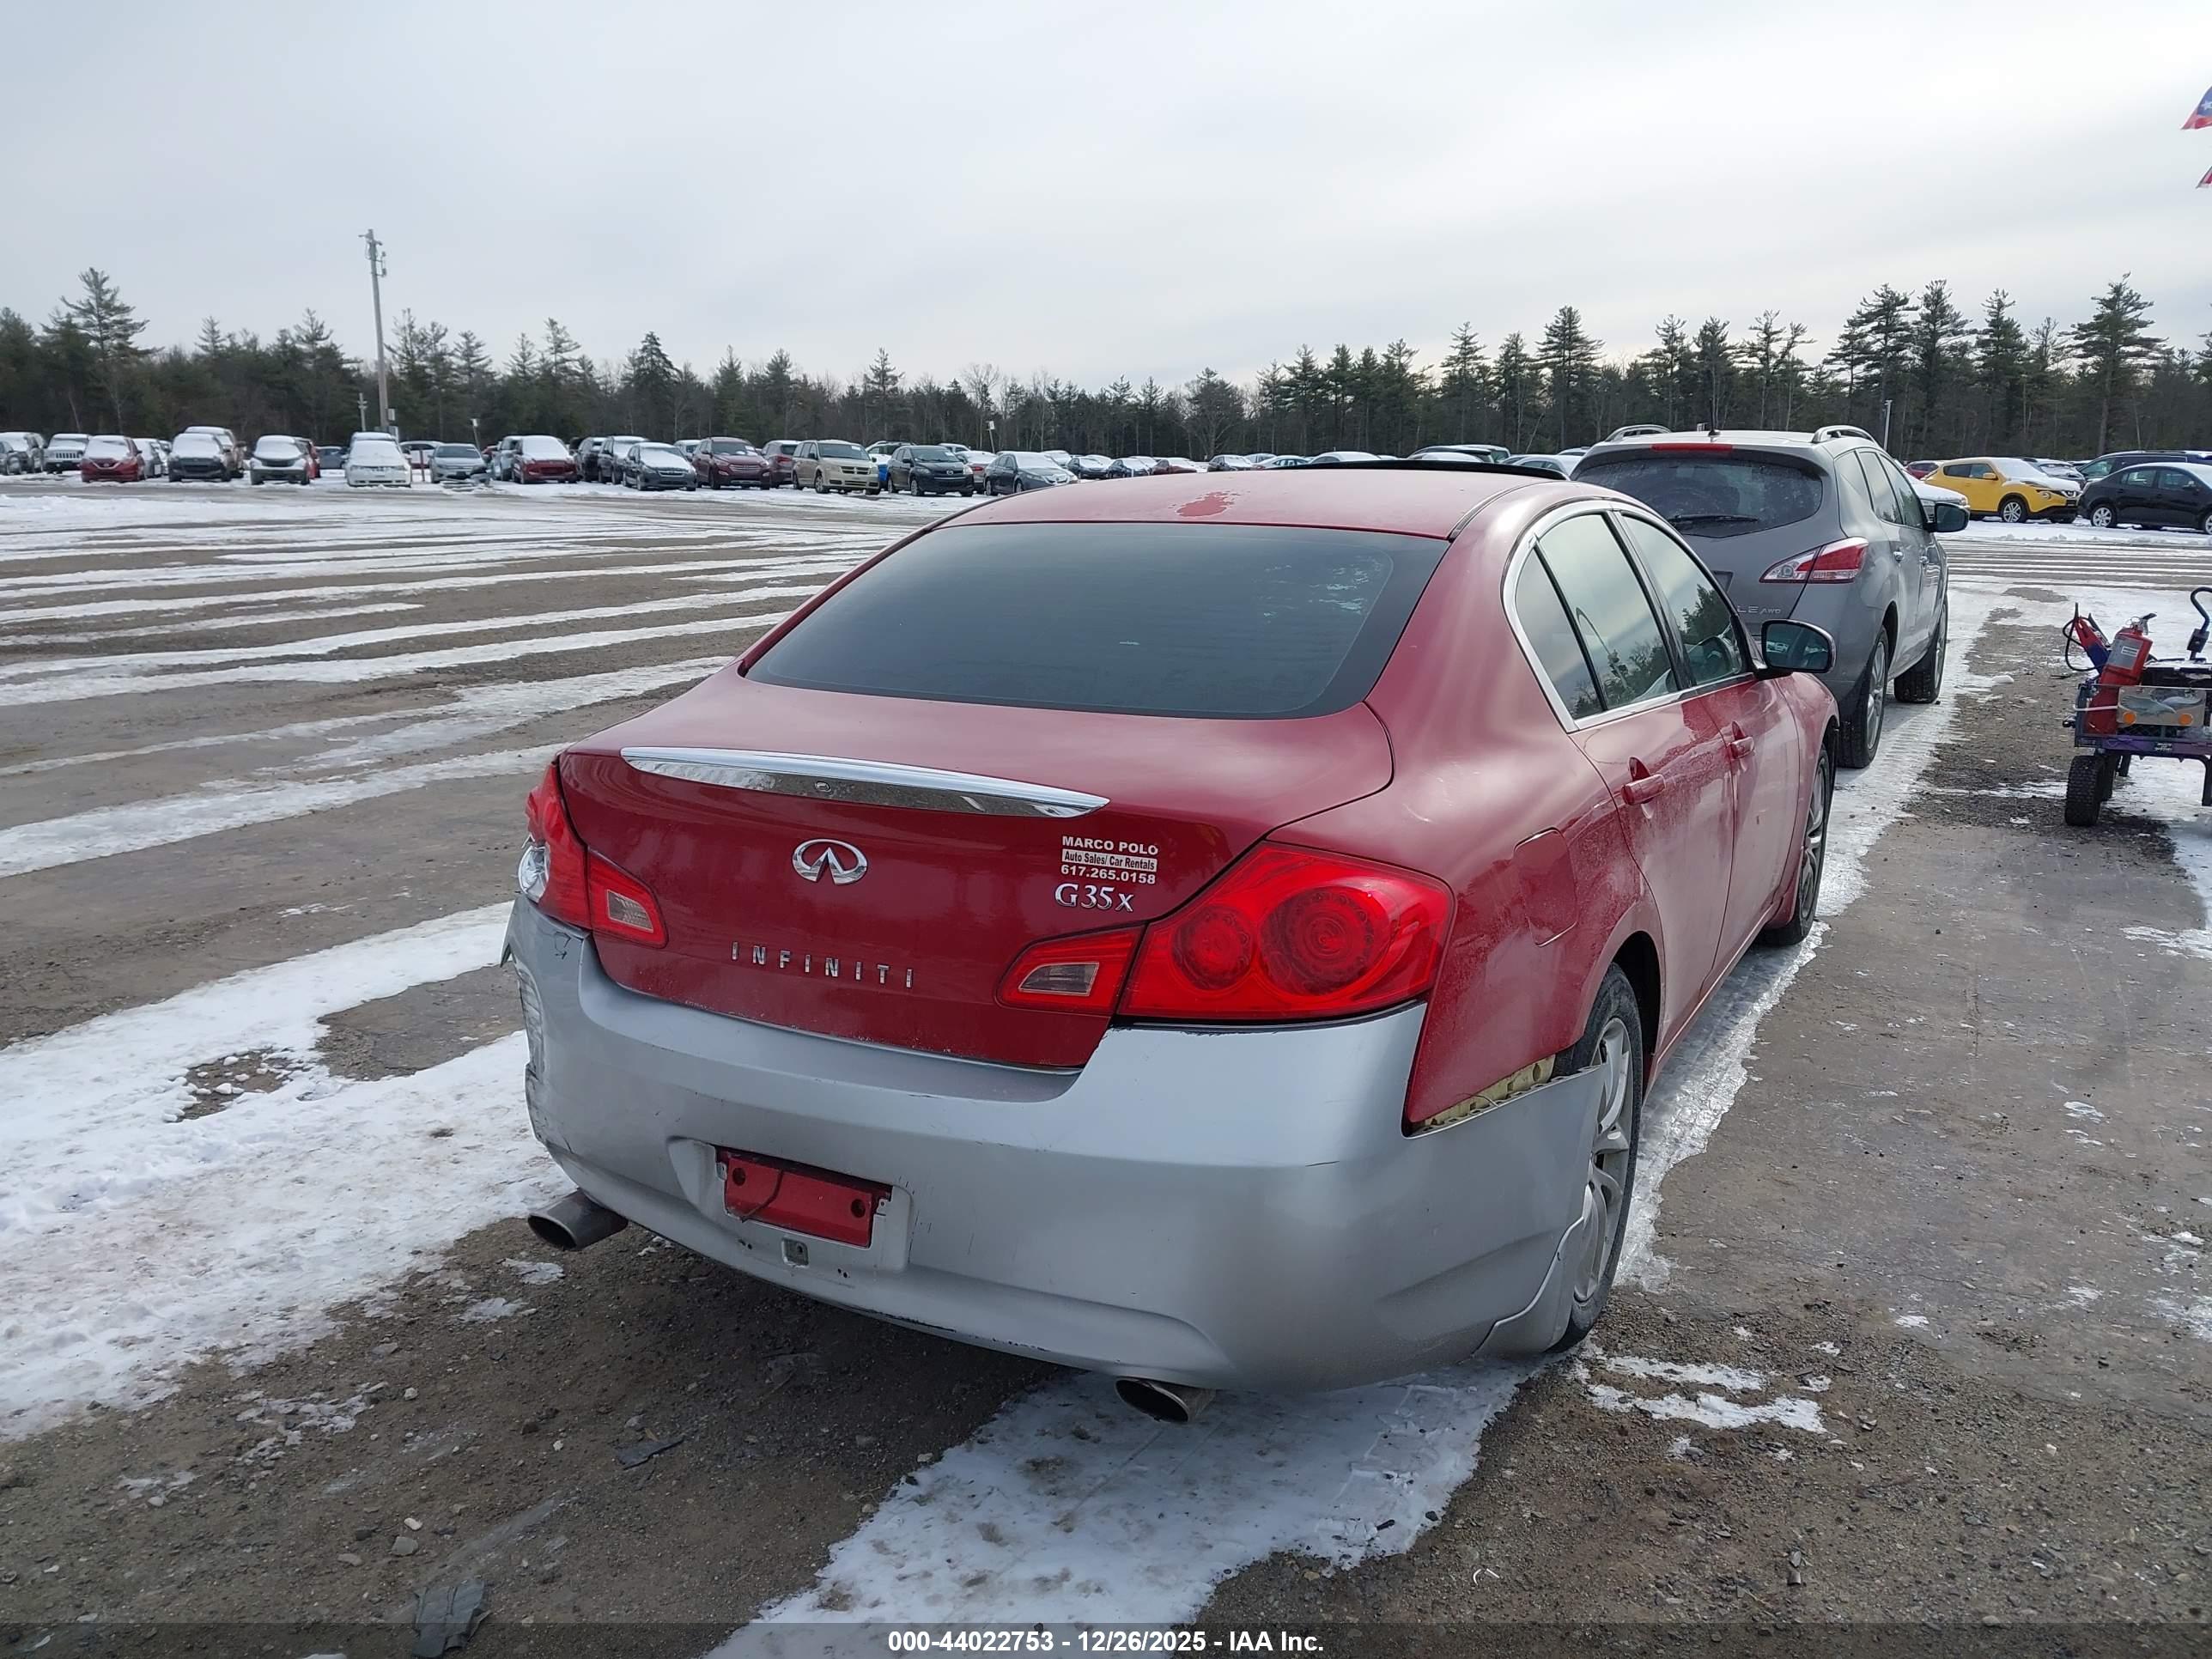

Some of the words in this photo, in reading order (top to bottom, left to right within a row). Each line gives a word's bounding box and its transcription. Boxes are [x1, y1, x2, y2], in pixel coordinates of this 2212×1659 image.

[1061, 836, 1115, 851] MARCO
[1118, 842, 1158, 855] POLO
[1064, 850, 1083, 862] Auto
[1084, 852, 1108, 866] Sales/
[1109, 856, 1123, 867] Car
[1124, 858, 1155, 871] Rentals
[1060, 864, 1156, 884] 617.265.0158
[732, 941, 913, 988] INFINITI
